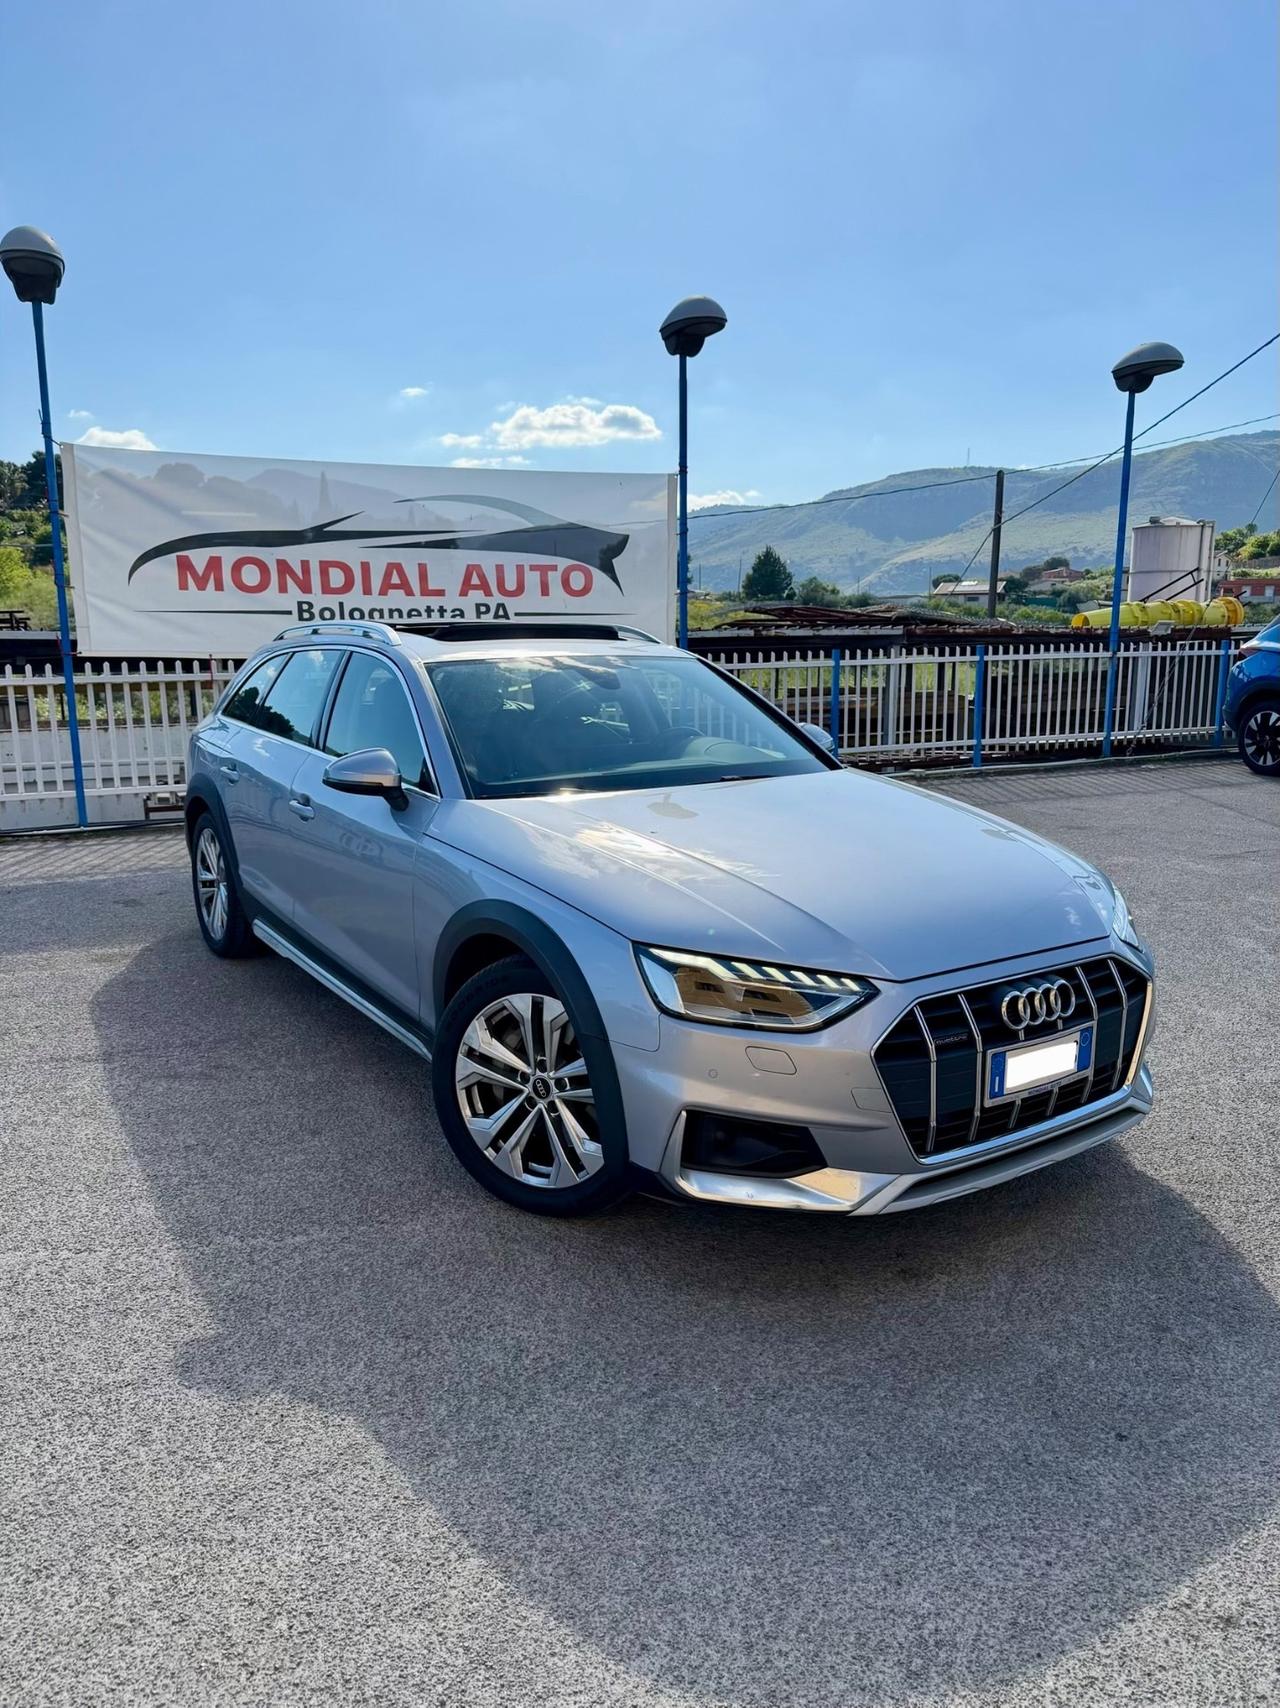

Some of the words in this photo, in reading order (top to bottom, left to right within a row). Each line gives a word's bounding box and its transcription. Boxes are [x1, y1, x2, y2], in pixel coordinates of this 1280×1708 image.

[176, 554, 446, 598] MONDIAL
[458, 563, 595, 598] AUTO
[474, 602, 511, 621] PA
